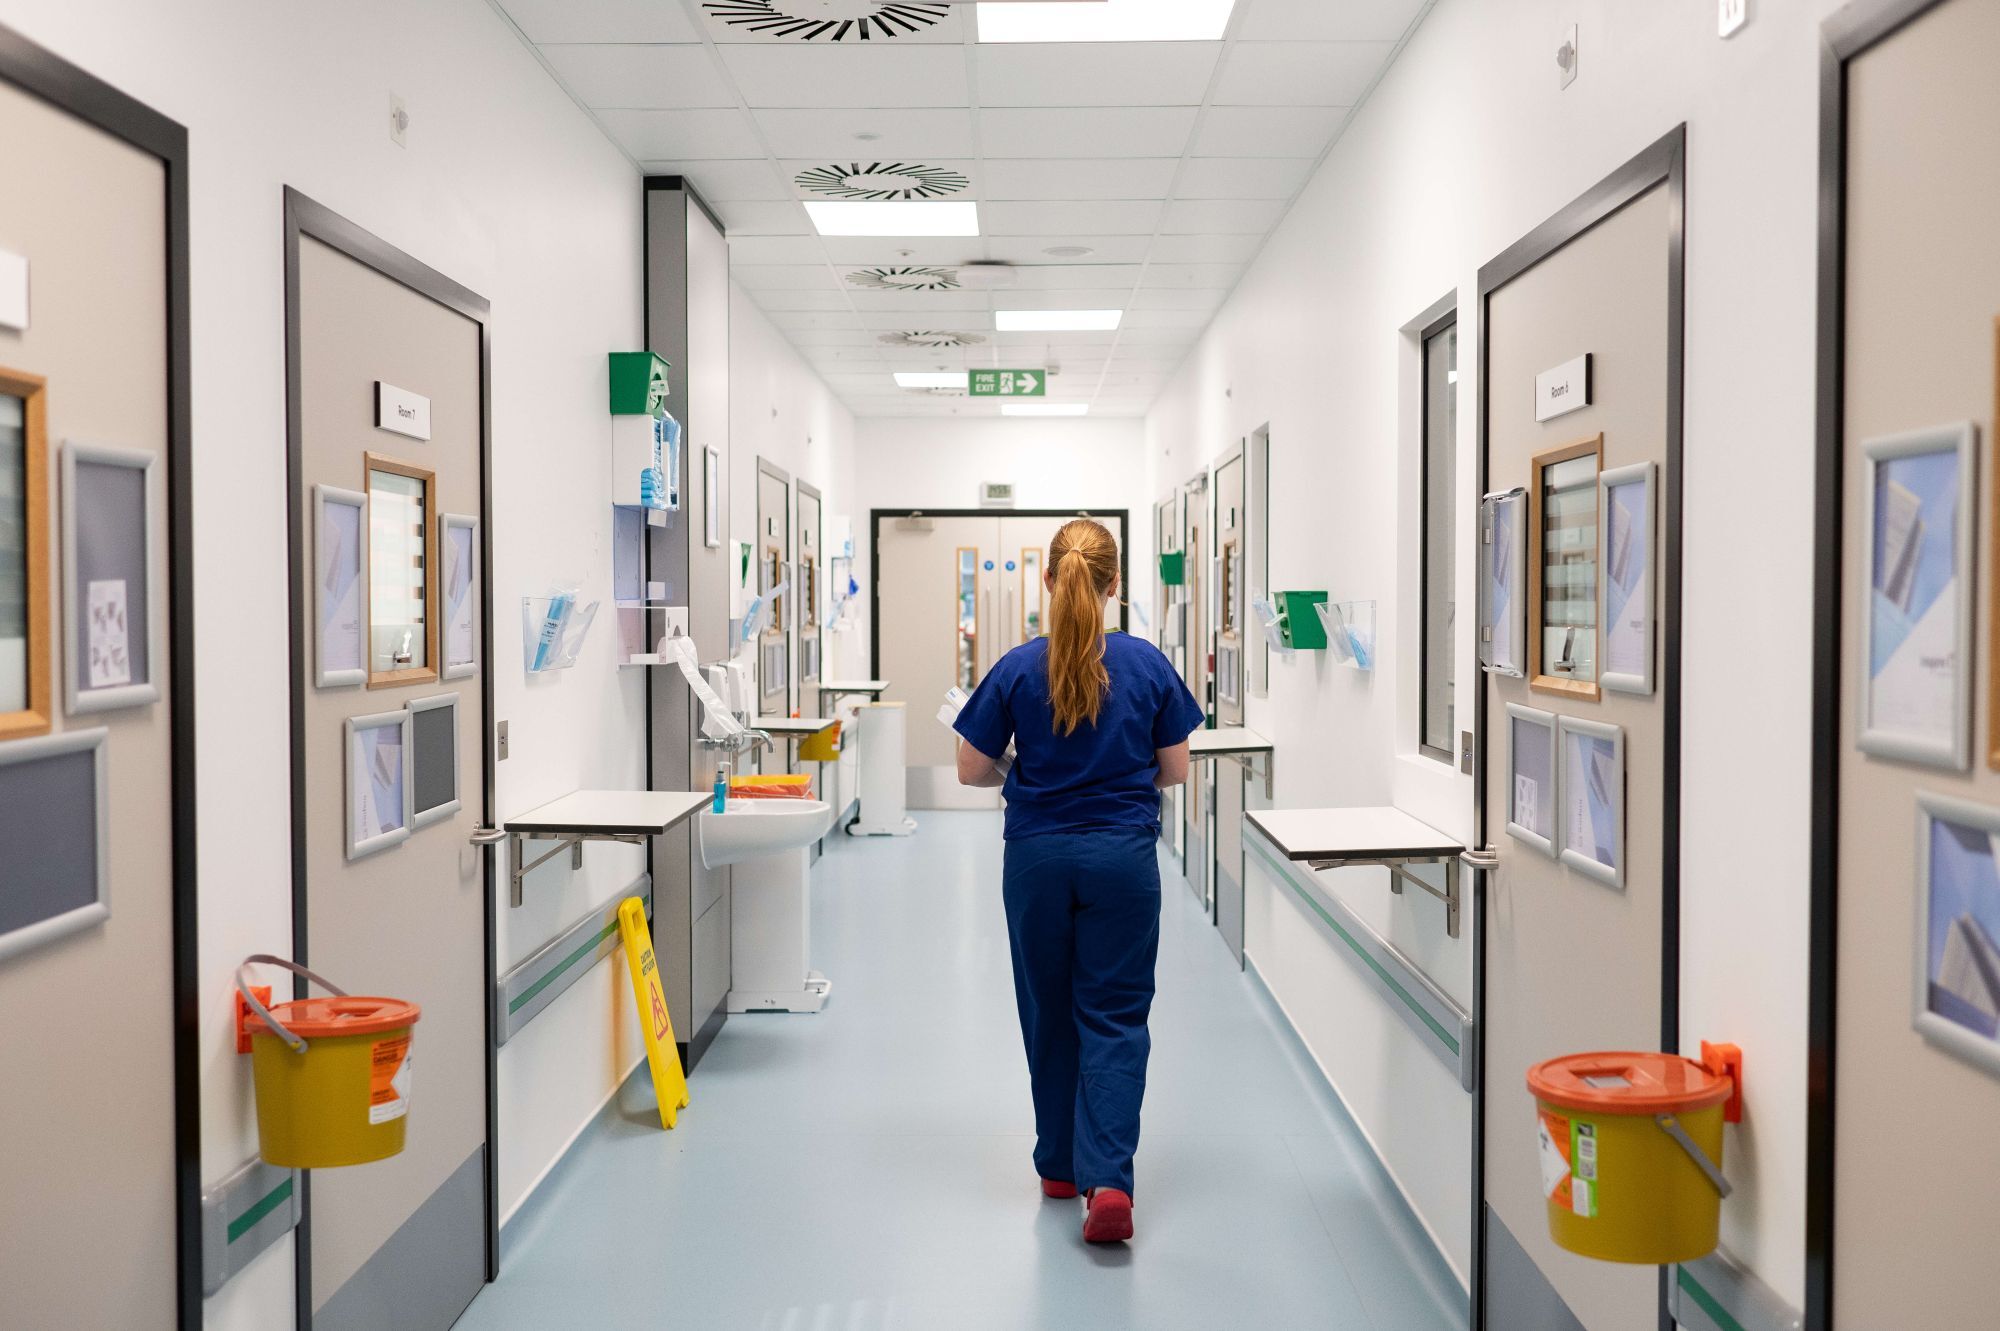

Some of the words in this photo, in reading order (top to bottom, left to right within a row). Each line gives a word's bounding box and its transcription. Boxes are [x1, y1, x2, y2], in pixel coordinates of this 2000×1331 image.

[975, 374, 995, 383] FIRE
[975, 384, 995, 393] EXIT
[1551, 386, 1564, 399] Room
[1565, 380, 1569, 394] 6
[398, 405, 412, 420] Room
[412, 409, 416, 420] 7
